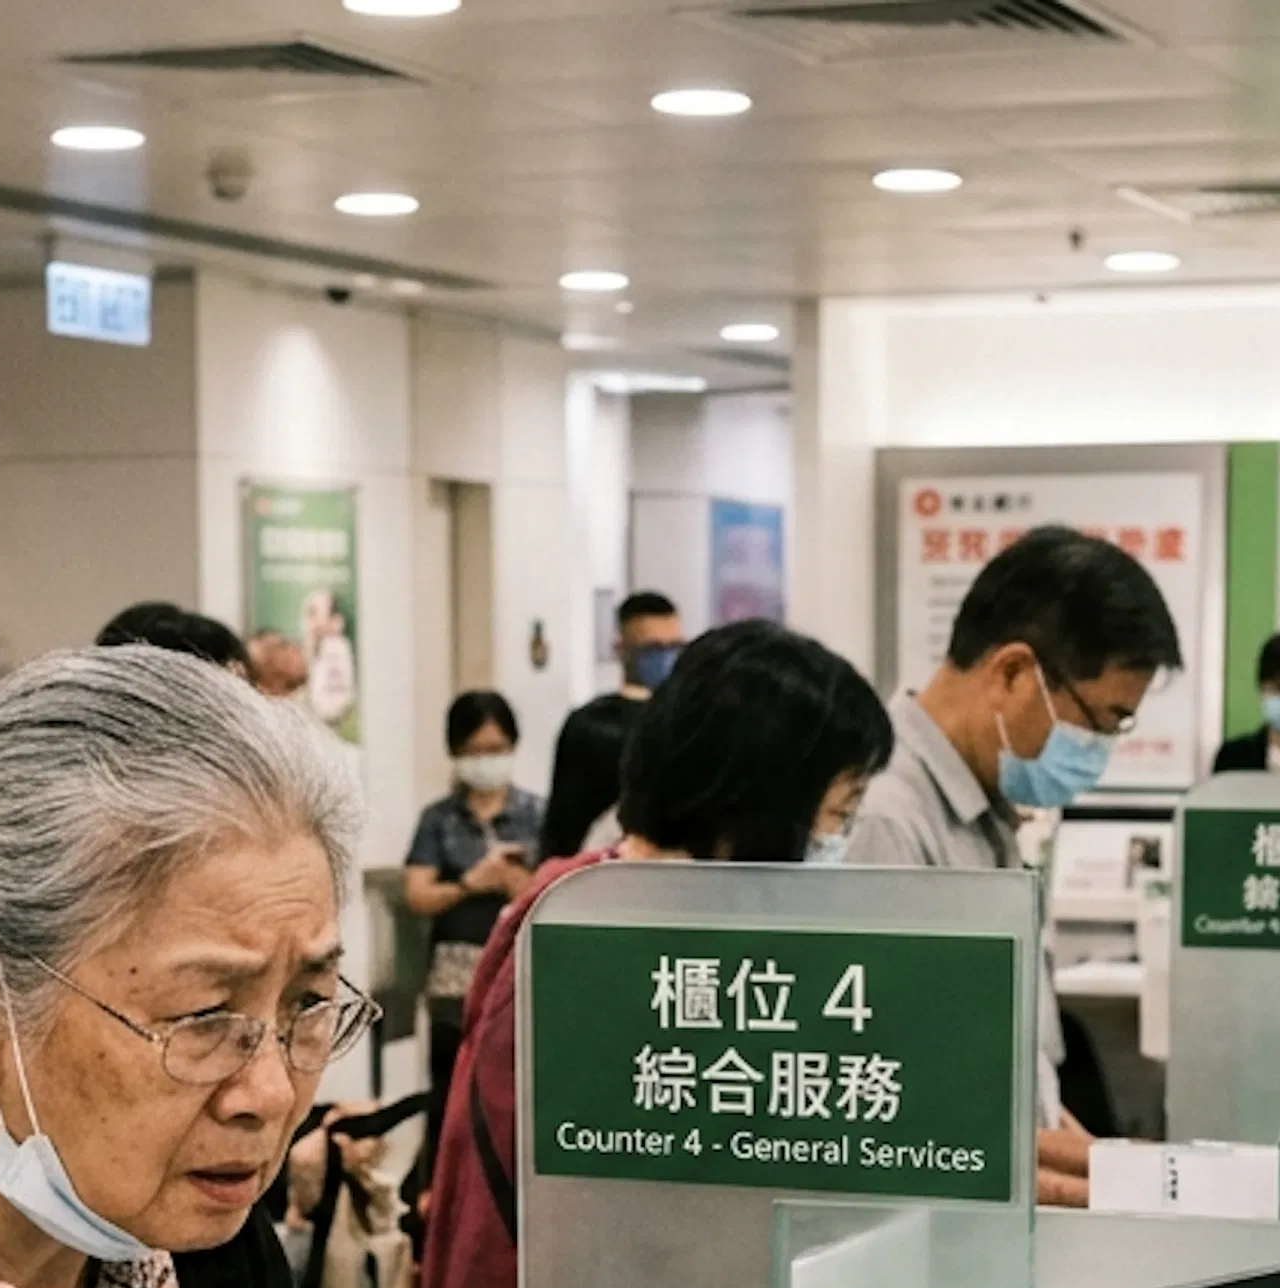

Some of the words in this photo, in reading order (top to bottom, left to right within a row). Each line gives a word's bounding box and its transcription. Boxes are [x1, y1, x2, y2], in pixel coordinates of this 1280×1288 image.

[650, 955, 798, 1033] 櫃位
[821, 963, 873, 1033] 4
[632, 1044, 903, 1122] 綜合服務
[557, 1122, 675, 1156] Counter
[683, 1127, 703, 1156] 4
[730, 1131, 849, 1165] General
[860, 1138, 986, 1172] Services
